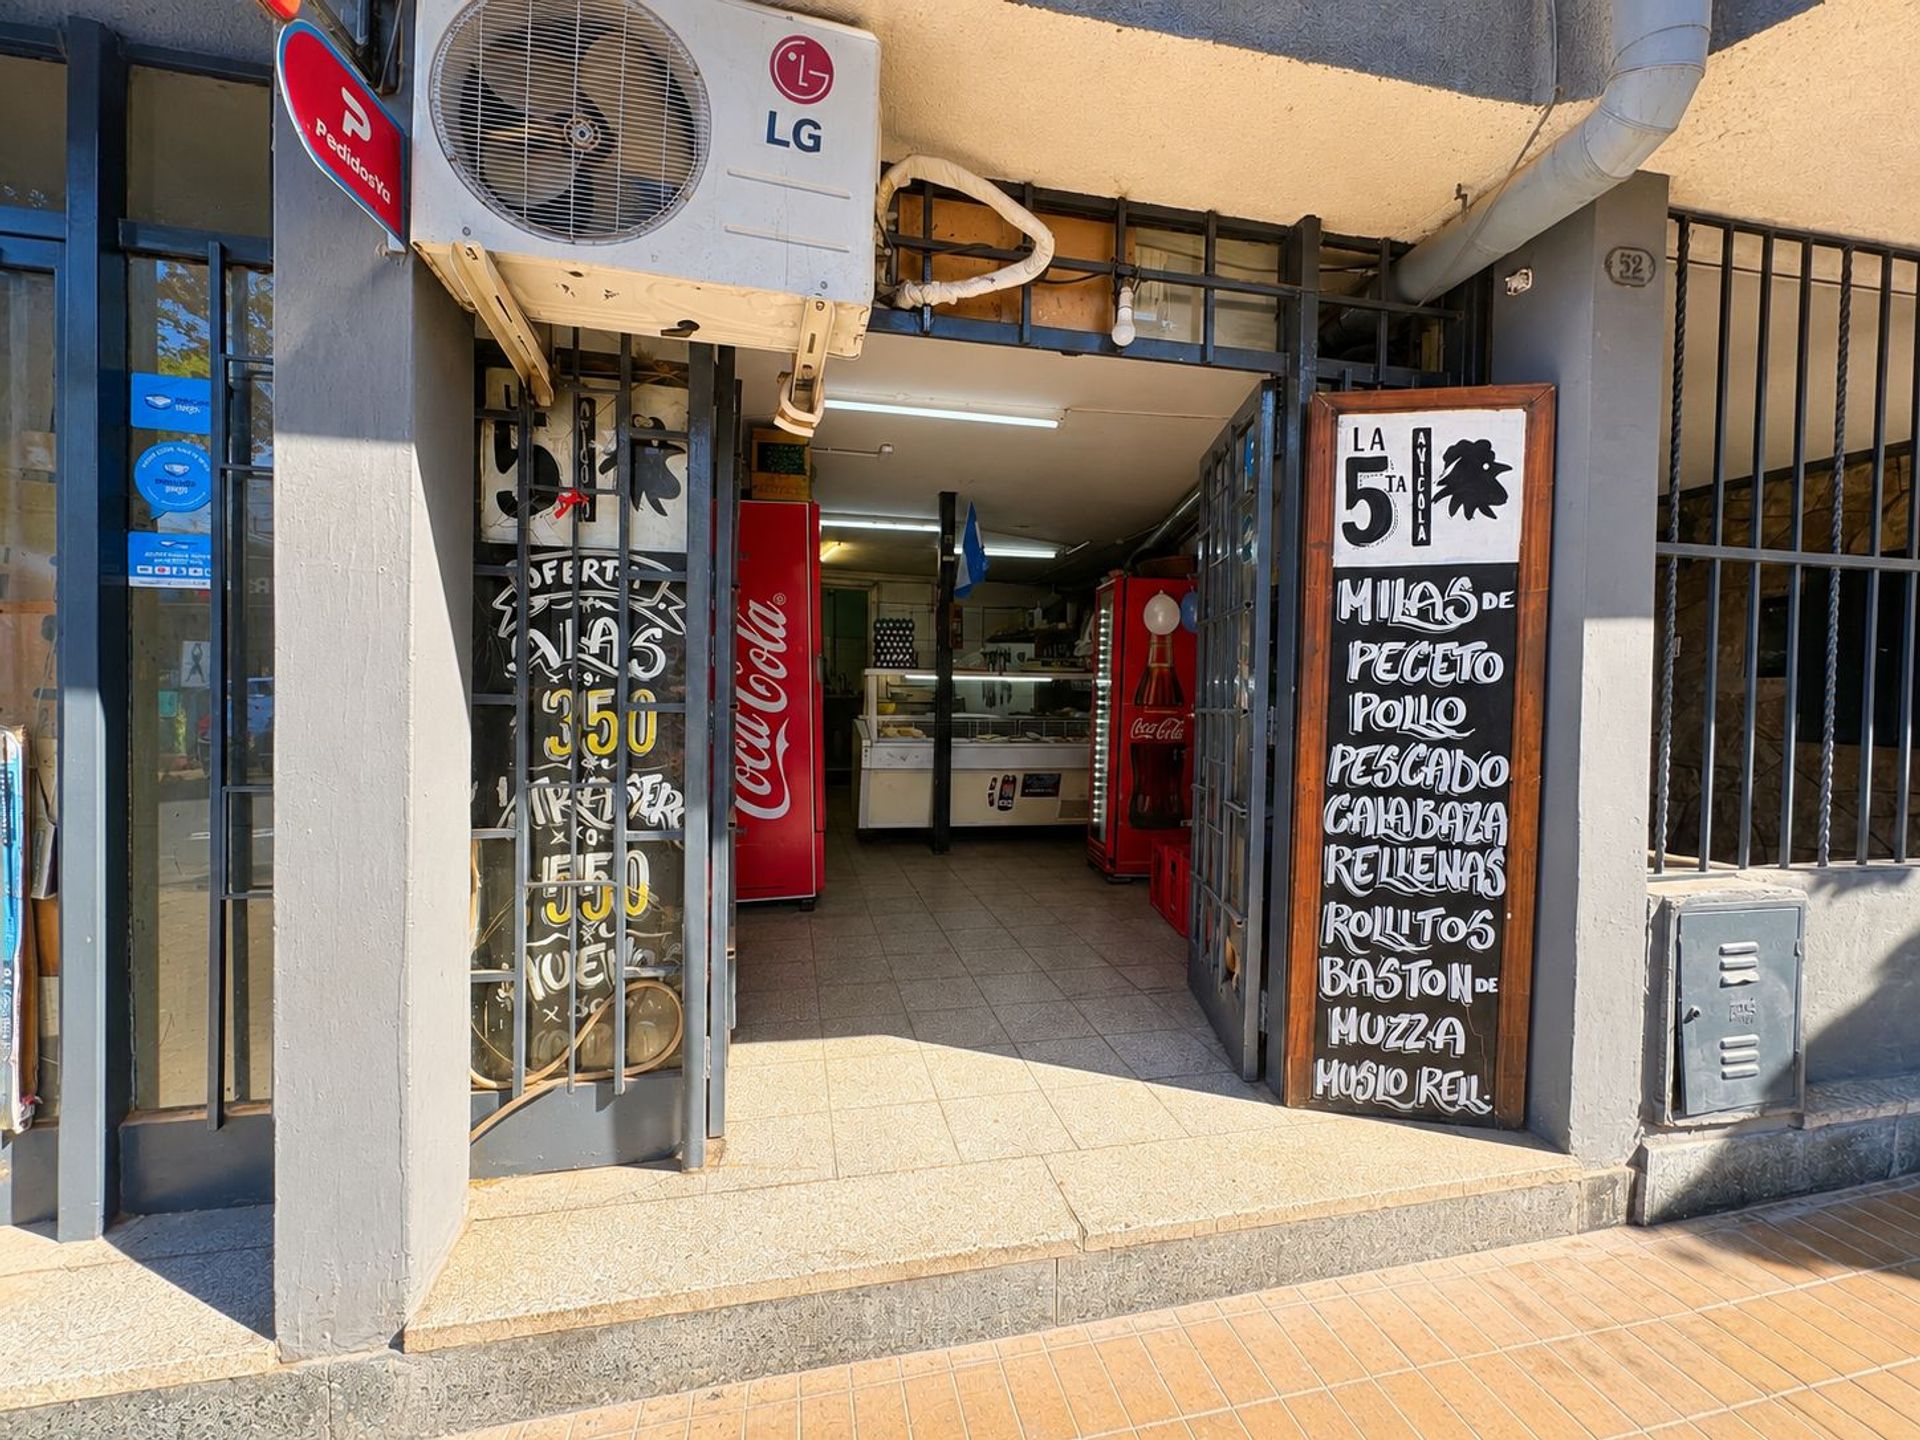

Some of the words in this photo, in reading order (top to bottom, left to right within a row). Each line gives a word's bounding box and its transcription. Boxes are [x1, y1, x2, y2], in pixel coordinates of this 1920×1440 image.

[766, 110, 822, 153] LG
[315, 117, 391, 205] PedidosYa
[1620, 252, 1643, 276] 52
[1353, 427, 1385, 452] LA
[1417, 431, 1427, 541] AVICOLA
[528, 558, 642, 590] OFERT
[1337, 576, 1479, 634] MILAS
[1482, 590, 1515, 610] DE
[1347, 640, 1504, 688] PECETO
[542, 688, 659, 760] 350
[1130, 717, 1184, 740] Coca-Cola
[1348, 692, 1476, 741] POLLO
[1327, 743, 1510, 796] PESCADO
[1323, 793, 1509, 847] CALABAZA
[540, 850, 651, 926] 550
[1323, 843, 1508, 899] RELLENAS
[1320, 901, 1496, 955] ROLLITOS
[1319, 955, 1473, 1007] BASTON
[1475, 977, 1498, 993] DE
[1328, 1006, 1466, 1058] MUZZA
[1313, 1058, 1415, 1112] MUSLO
[1415, 1066, 1493, 1115] RELL.
